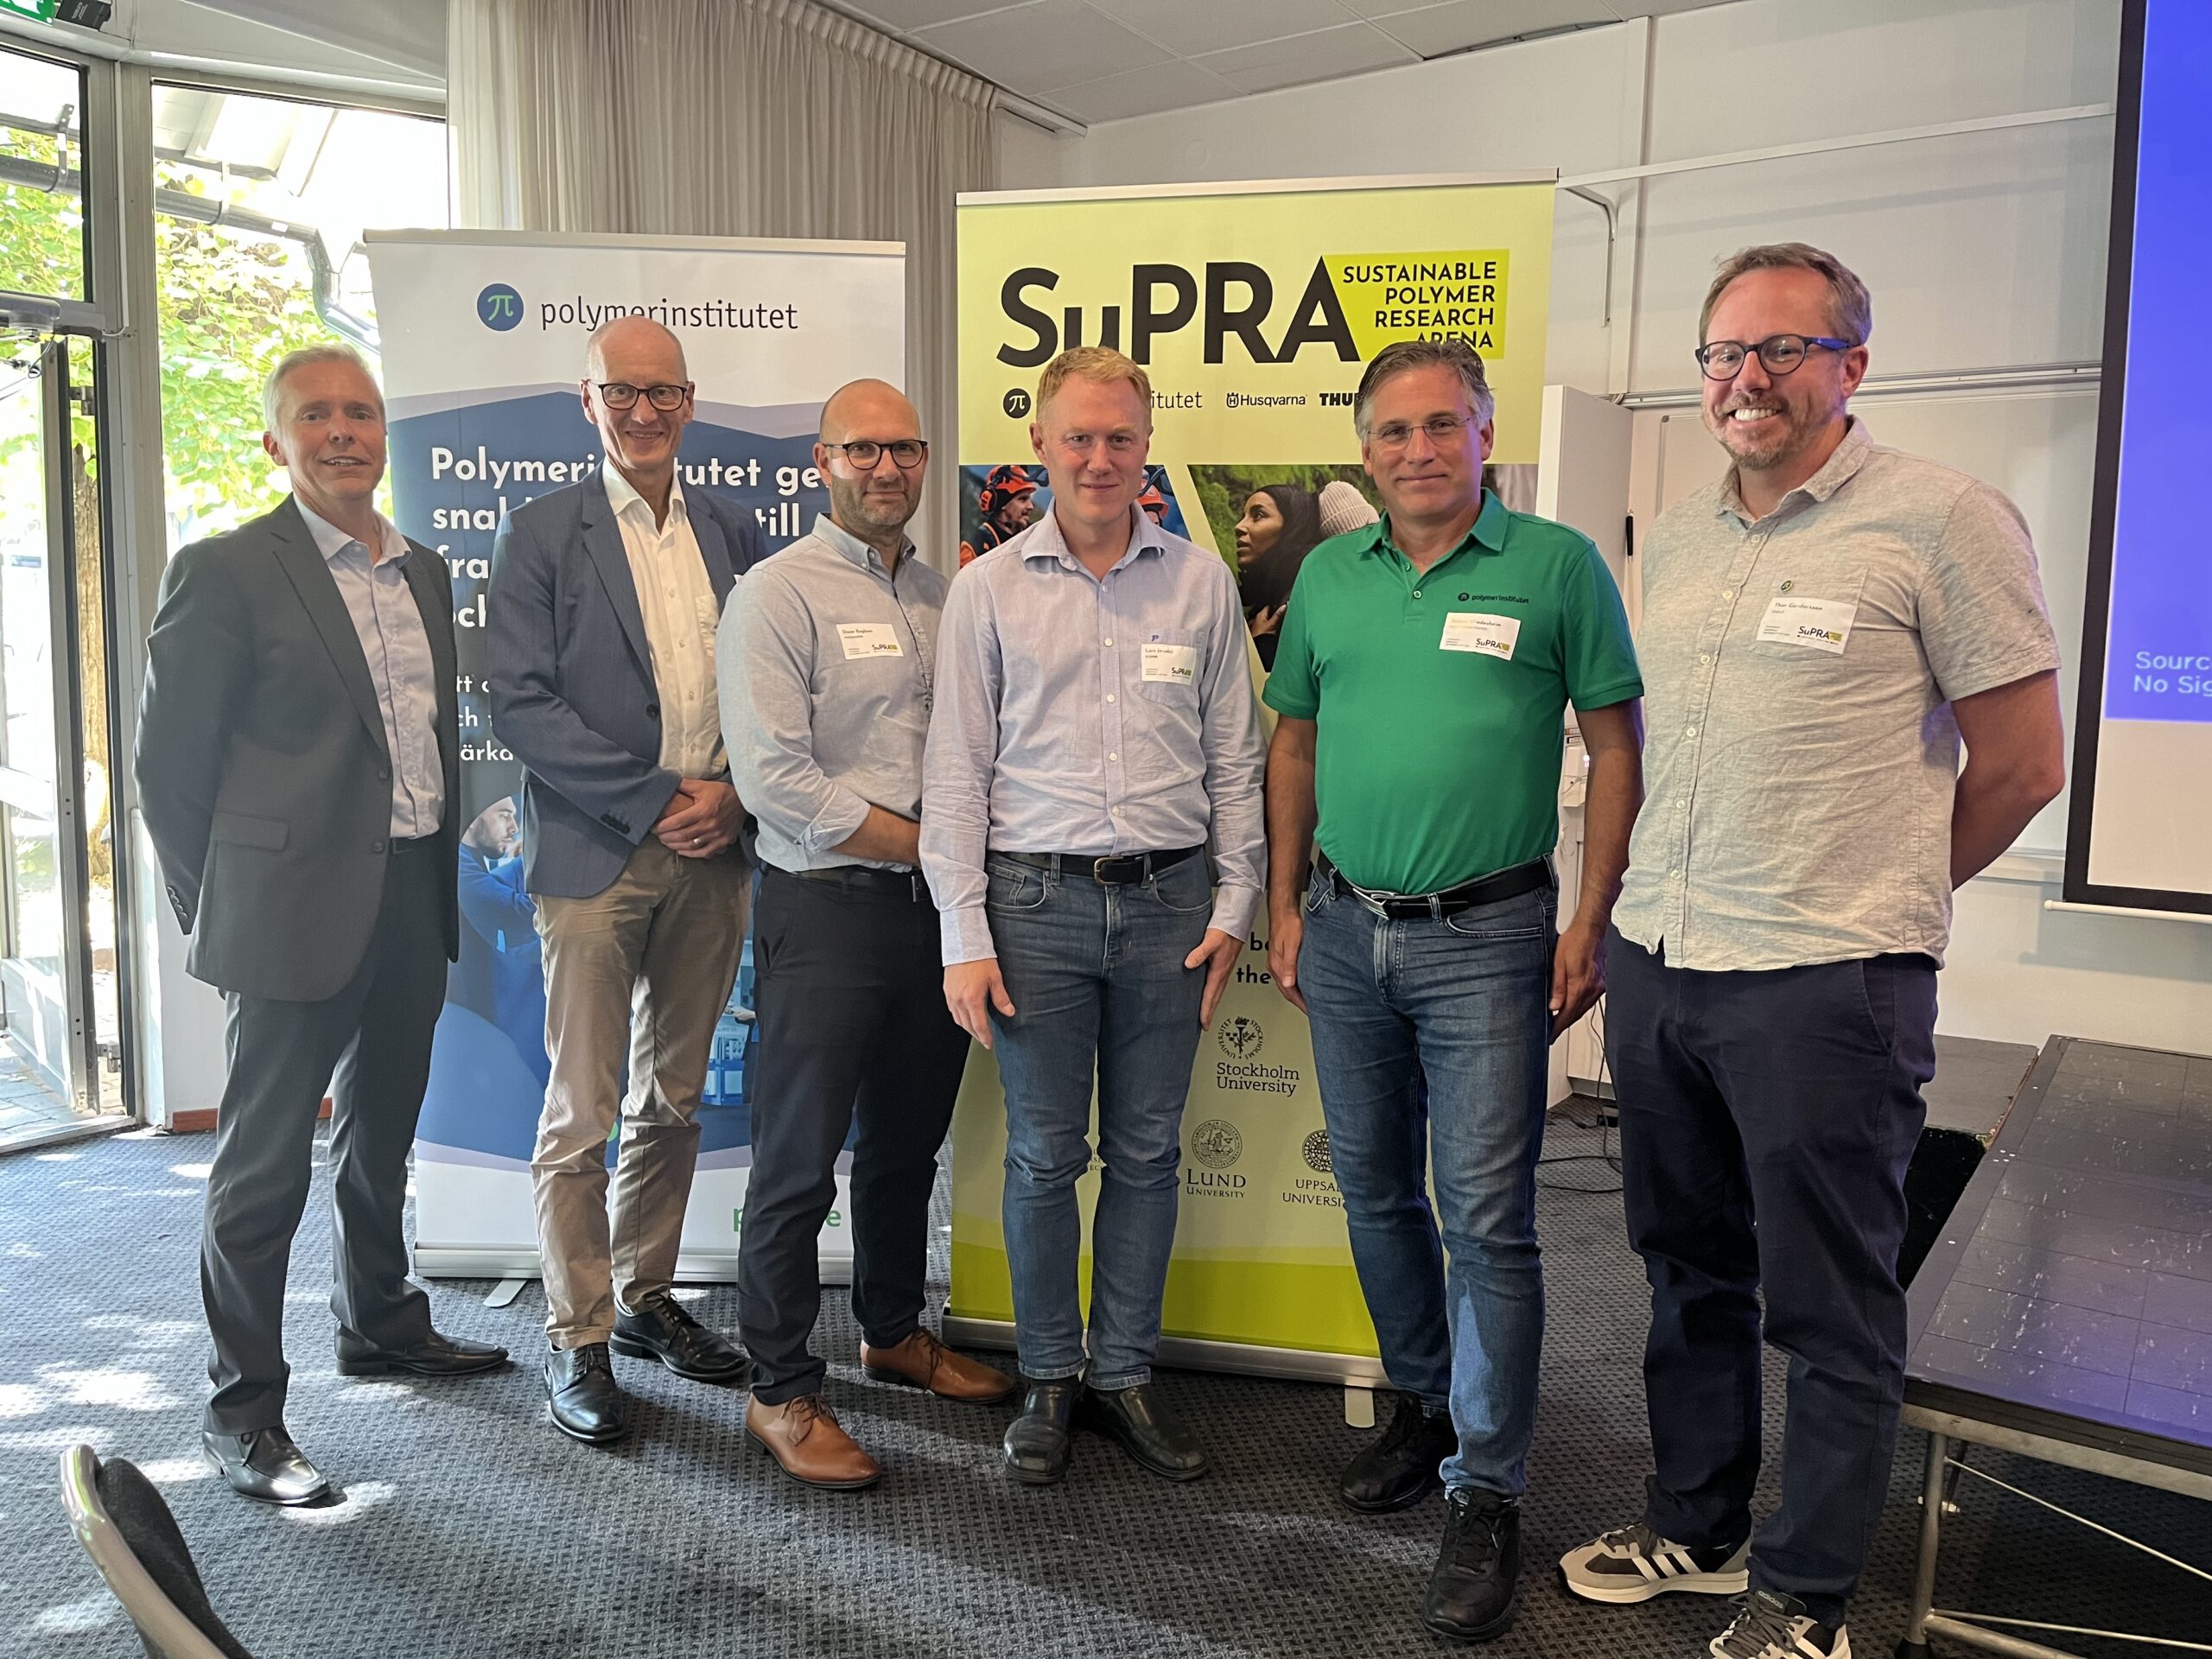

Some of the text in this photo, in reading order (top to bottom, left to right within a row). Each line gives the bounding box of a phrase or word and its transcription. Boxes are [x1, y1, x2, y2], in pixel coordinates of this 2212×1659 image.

[1343, 262, 1497, 283] SUSTAINABLE
[1385, 285, 1496, 304] POLYMER
[541, 296, 798, 332] polymerinstitutet
[996, 256, 1362, 367] SuPRA
[1376, 308, 1494, 327] RESEARCH
[1240, 393, 1306, 407] Husqvarna
[1319, 392, 1358, 406] THU
[775, 466, 830, 496] ge
[1471, 594, 1529, 604] polymerinstitutet
[1798, 626, 1830, 639] SuPRA
[1476, 638, 1502, 650] SuPRA
[2133, 675, 2169, 693] No
[1236, 963, 1272, 984] the
[1217, 1062, 1300, 1080] Stockholm
[1217, 1077, 1297, 1097] University
[1186, 1168, 1247, 1188] LUND
[1186, 1186, 1245, 1198] UNIVERSITY
[1758, 1591, 1784, 1609] adidas
